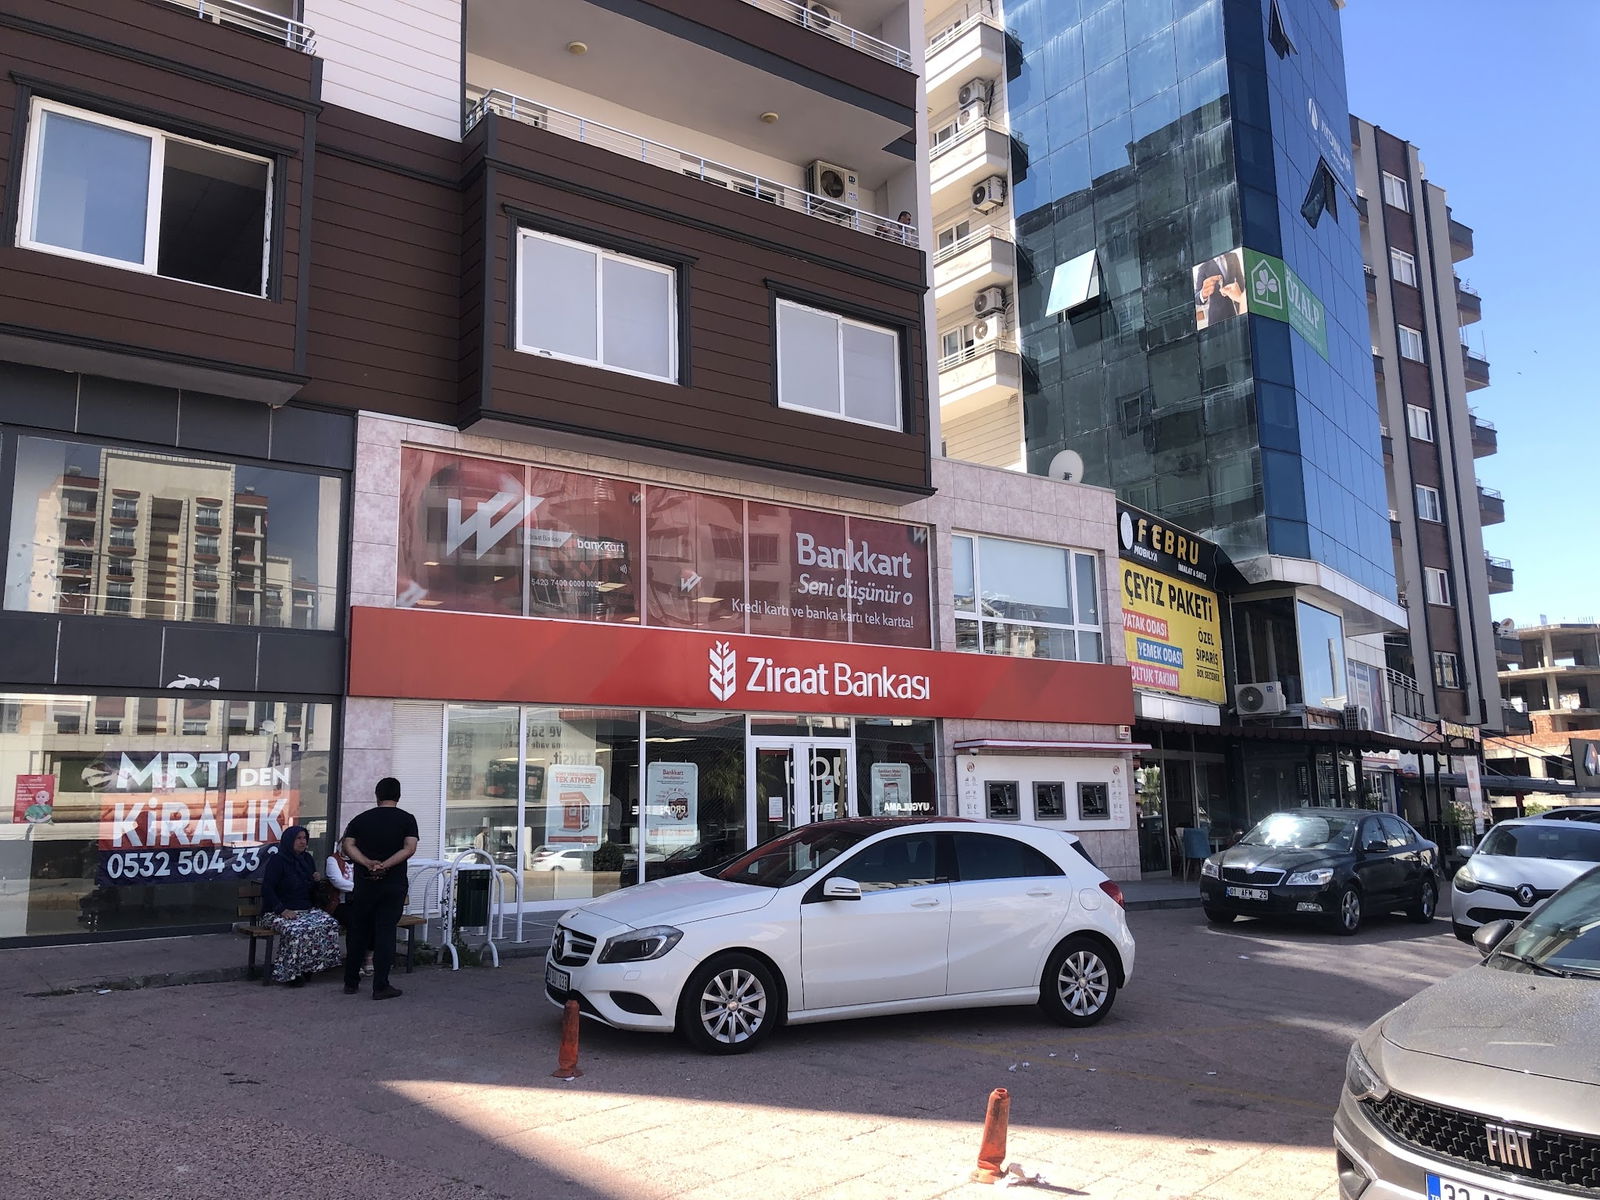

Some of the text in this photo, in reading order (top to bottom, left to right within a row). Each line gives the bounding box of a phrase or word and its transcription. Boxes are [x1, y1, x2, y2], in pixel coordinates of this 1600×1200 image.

[1286, 268, 1320, 329] ÖZALP
[796, 532, 912, 578] Bankkart
[1137, 518, 1199, 565] FEBRU
[798, 573, 913, 605] Seni düşünür o
[731, 598, 914, 629] Kredi kartı ve banka kartı tek kartta!
[1122, 611, 1167, 637] YATAK ODASI
[1197, 626, 1214, 646] ÖZEL
[1137, 641, 1183, 665] YEMEK ODASI
[746, 656, 931, 700] Ziraat Bankası
[1131, 665, 1154, 683] OLTUK
[240, 767, 291, 787] DEN
[107, 847, 260, 879] 0532 504 33
[1484, 1123, 1533, 1170] FIAT
